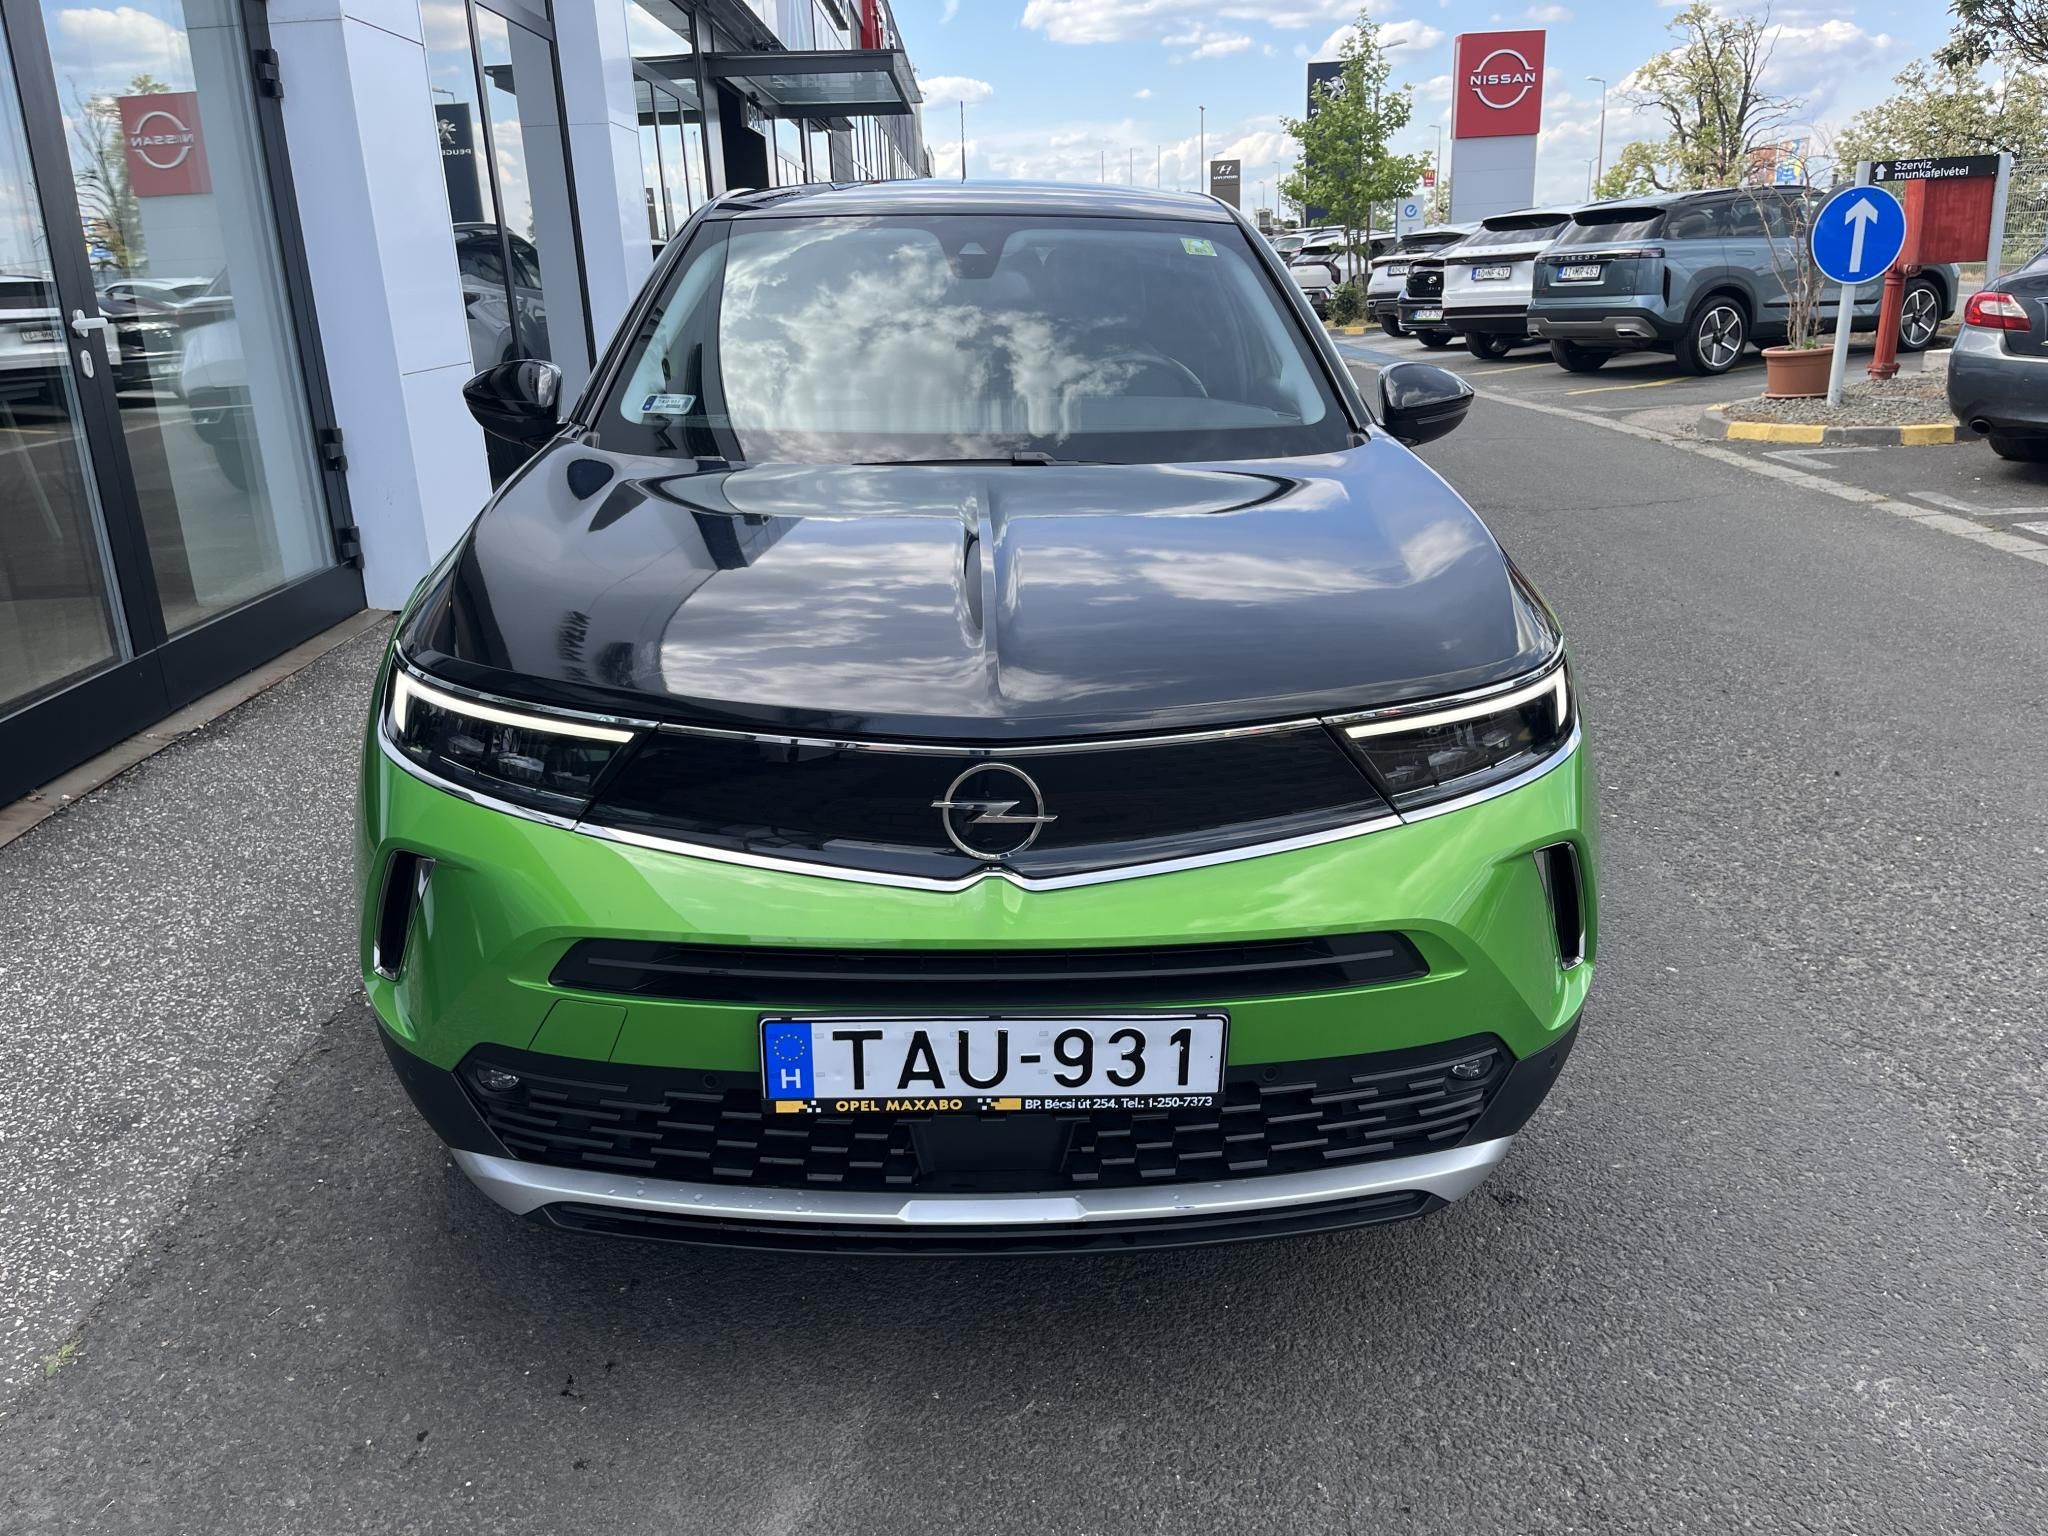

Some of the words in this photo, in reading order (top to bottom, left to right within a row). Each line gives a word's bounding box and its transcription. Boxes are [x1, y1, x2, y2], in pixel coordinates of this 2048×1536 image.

[1470, 72, 1536, 86] NISSAN
[1894, 159, 1933, 171] Szerviz
[1894, 165, 1969, 180] munkafelvétel
[780, 1068, 802, 1089] H
[832, 1027, 1193, 1091] TAU-931
[836, 1100, 880, 1112] OPEL
[885, 1099, 963, 1112] MAXABO
[1025, 1099, 1042, 1110] BP.
[1045, 1098, 1075, 1109] Bécsi
[1078, 1098, 1091, 1109] út
[1093, 1098, 1119, 1109] 254.
[1121, 1097, 1144, 1109] Tel.:
[1148, 1096, 1213, 1109] 1-250-7373
